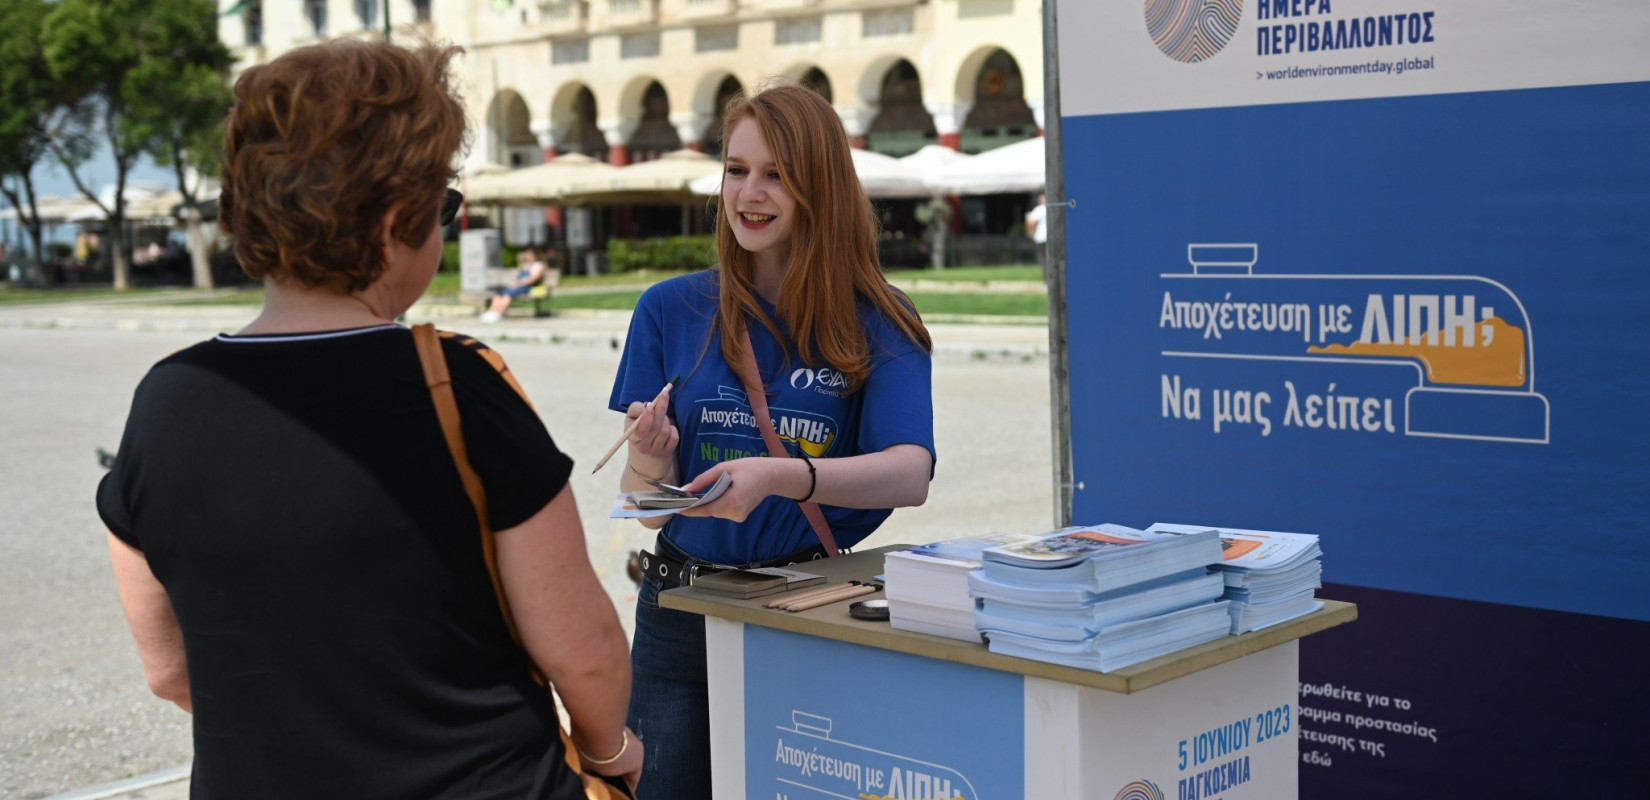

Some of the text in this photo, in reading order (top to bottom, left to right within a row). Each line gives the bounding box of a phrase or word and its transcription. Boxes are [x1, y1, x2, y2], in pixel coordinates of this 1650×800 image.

[1257, 11, 1435, 56] ΠΕΡΙΒΑΛΛΟΝΤΟΣ
[1160, 291, 1311, 343] Αποχέτευση
[1319, 304, 1353, 343] με
[1161, 375, 1396, 436] Να μας λείπει
[1366, 693, 1390, 708] για
[1393, 698, 1412, 711] το
[1178, 703, 1291, 771] 5 ΙΟΥΝΙΟΥ 2023
[1345, 713, 1438, 743] προστασίας
[1358, 739, 1386, 758] της
[776, 738, 861, 791] Αποχέτευση
[865, 766, 885, 793] με
[1178, 755, 1251, 800] ΠΑΓΚΟΣΜΙΑ
[1303, 750, 1332, 767] εδώ
